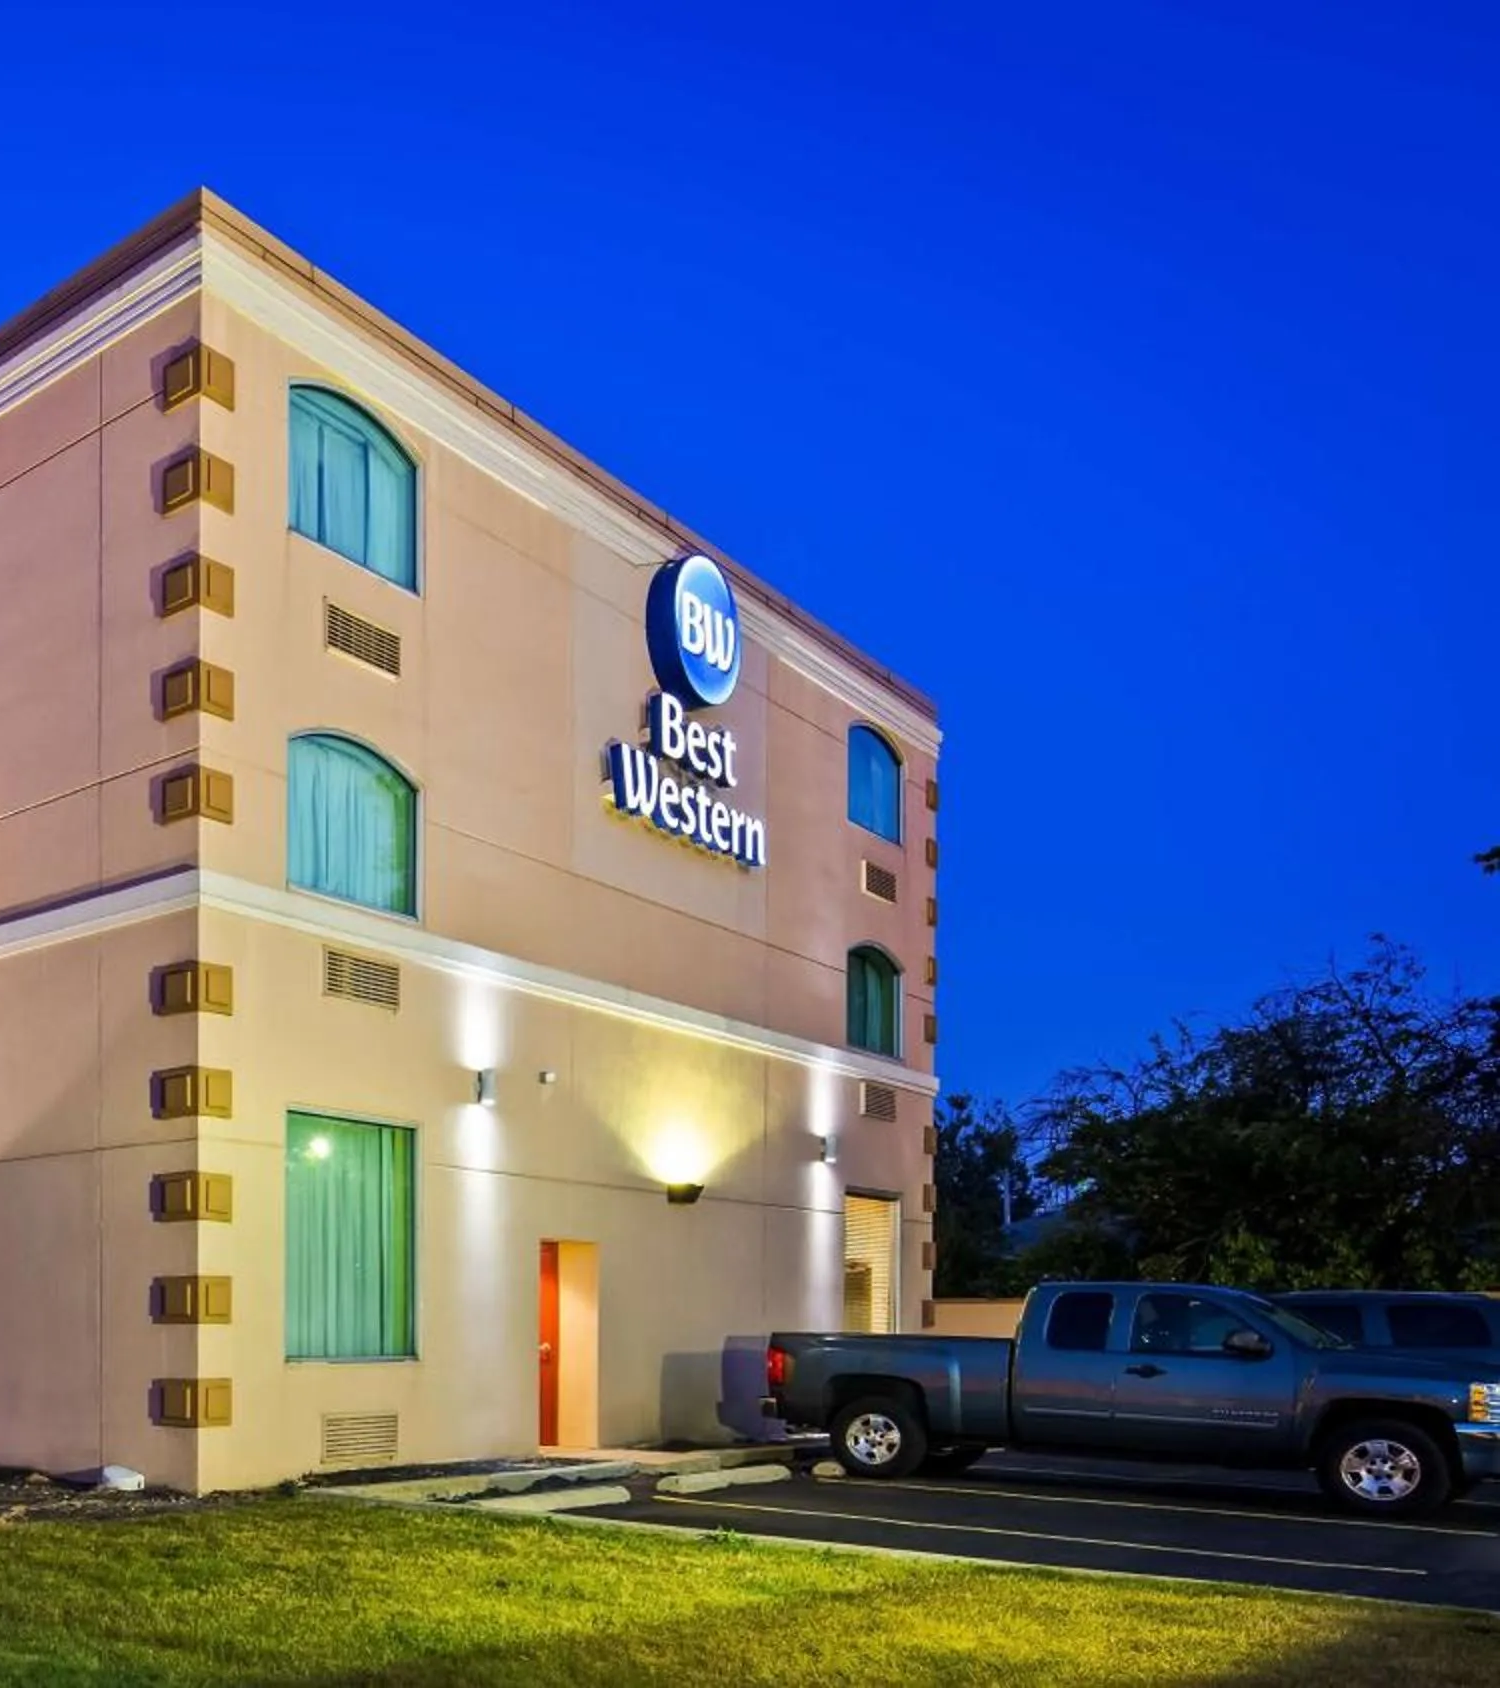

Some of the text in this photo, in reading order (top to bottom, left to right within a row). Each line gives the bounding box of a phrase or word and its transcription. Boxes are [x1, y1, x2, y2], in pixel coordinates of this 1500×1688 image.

[681, 591, 735, 672] BW
[661, 692, 738, 788] Best
[621, 743, 767, 866] Western
